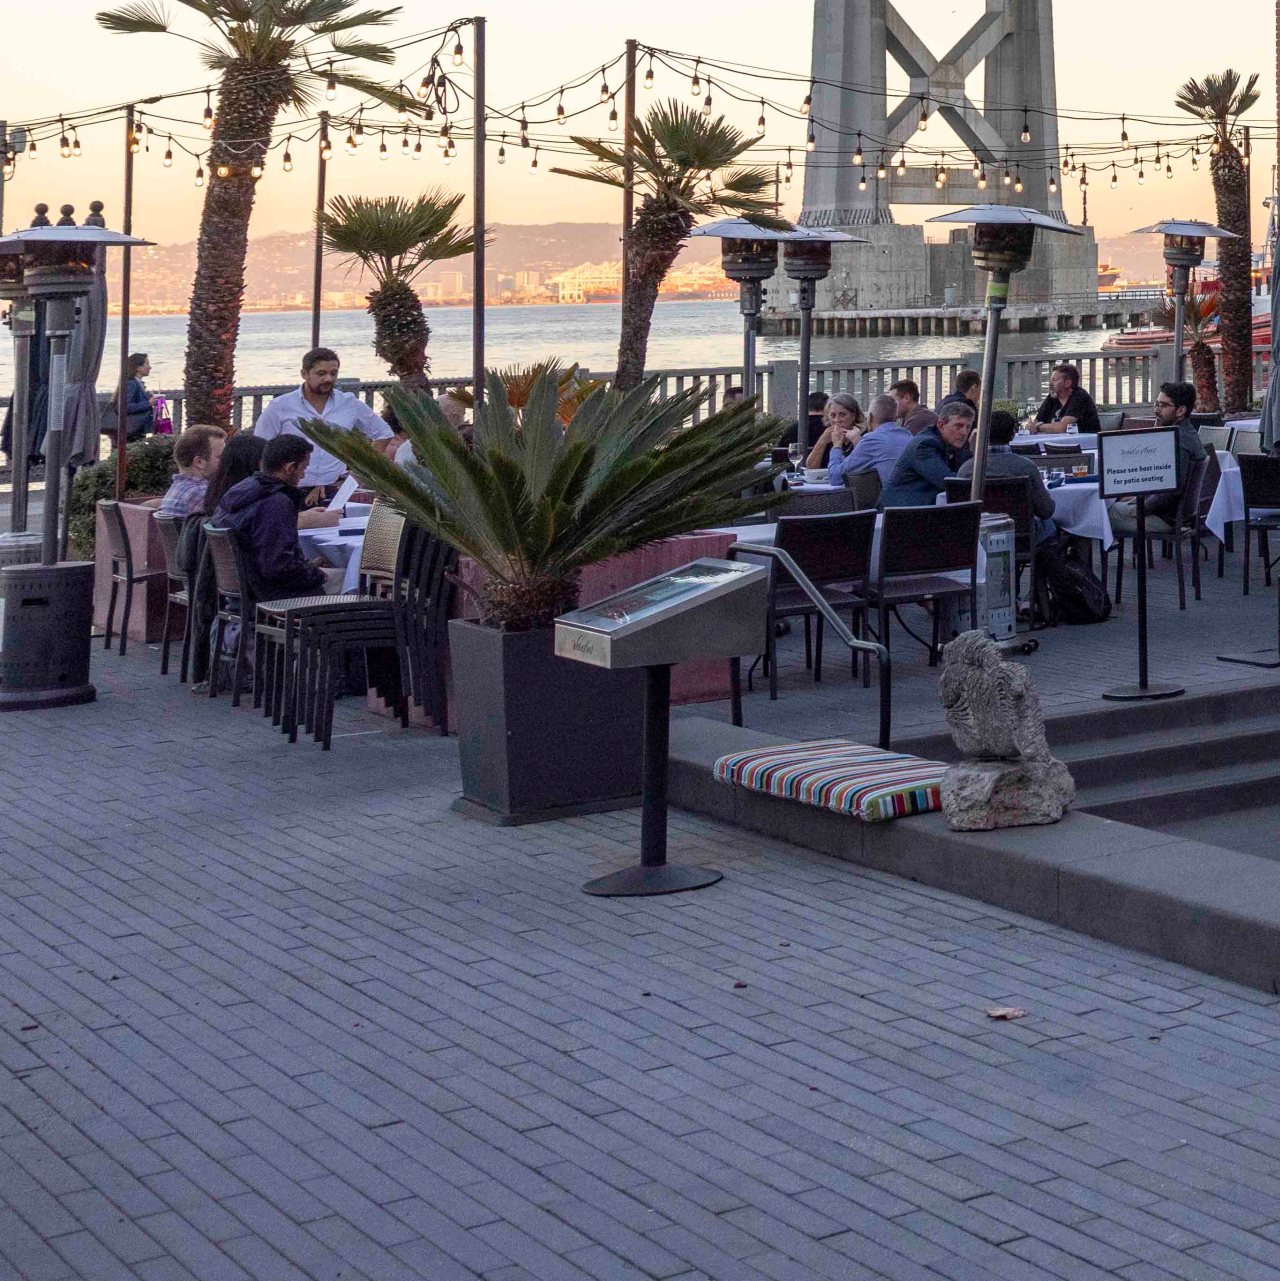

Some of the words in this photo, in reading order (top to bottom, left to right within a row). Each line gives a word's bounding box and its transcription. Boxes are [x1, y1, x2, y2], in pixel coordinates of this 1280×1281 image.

[1106, 467, 1126, 475] Please
[1153, 463, 1172, 471] inside
[1124, 477, 1140, 486] patio
[1141, 475, 1164, 483] seating
